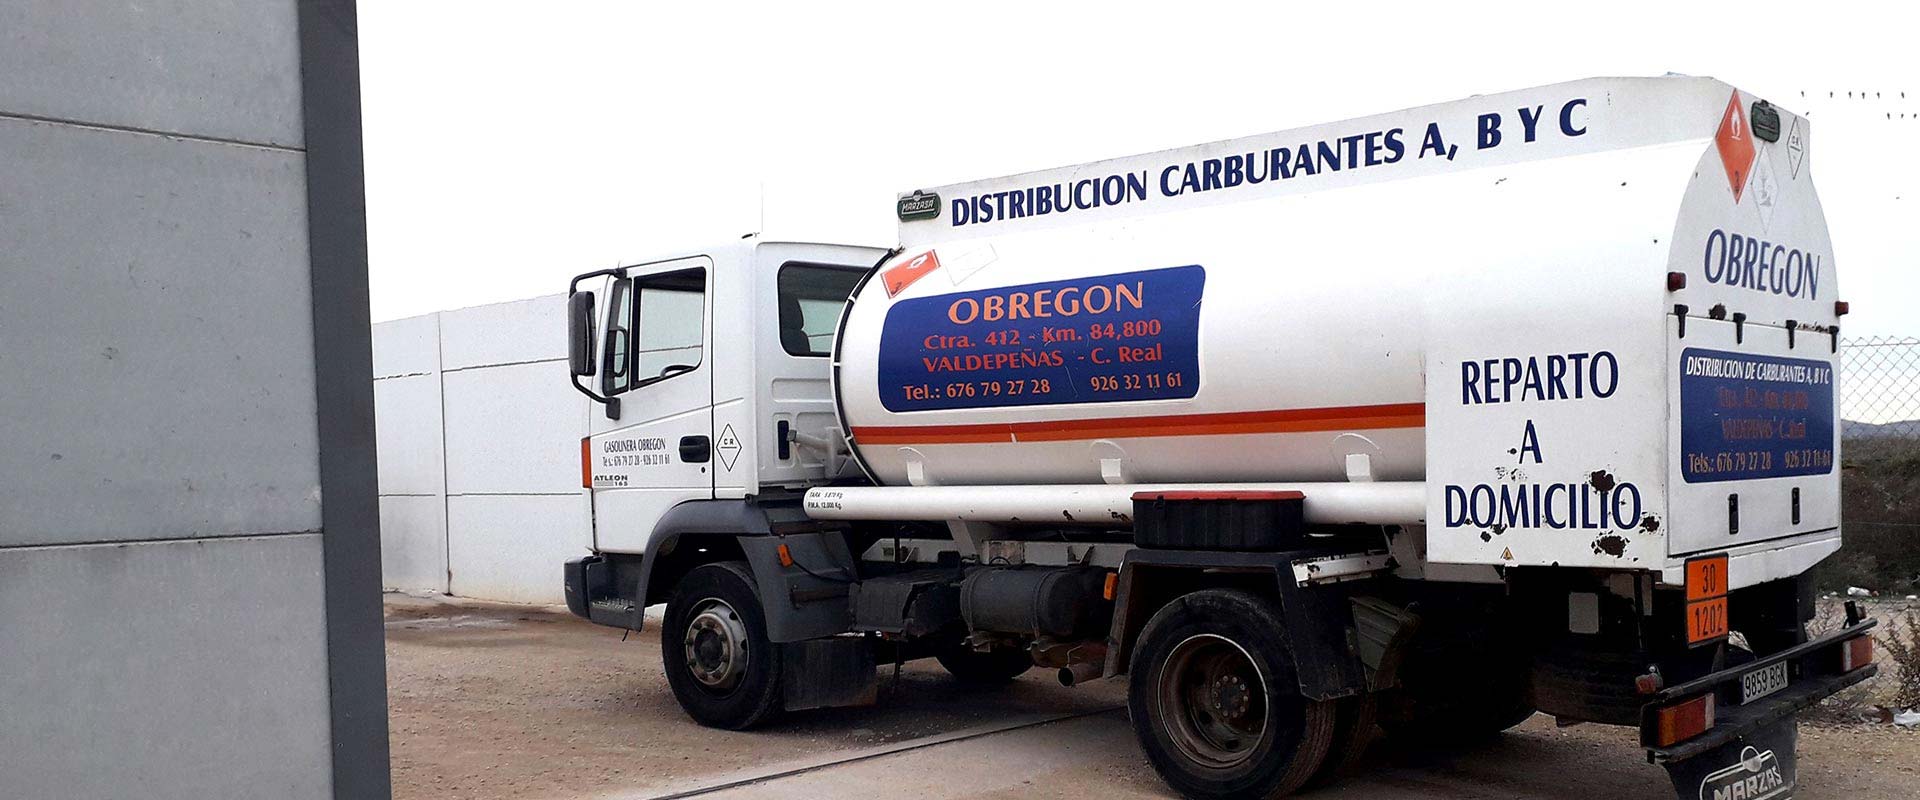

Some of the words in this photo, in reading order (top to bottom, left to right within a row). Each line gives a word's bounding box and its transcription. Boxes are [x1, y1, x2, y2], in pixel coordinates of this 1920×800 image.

[951, 171, 1147, 227] DISTRIBUCION
[1160, 127, 1404, 197] CARBURANTES
[1418, 121, 1458, 161] A,
[1477, 112, 1502, 150] B
[1517, 106, 1544, 143] Y
[1558, 99, 1588, 137] C
[902, 199, 934, 212] MARZASA
[1705, 229, 1820, 300] OBREGON
[948, 281, 1144, 325] OBREGON
[923, 334, 976, 350] Ctra.
[984, 330, 1020, 346] 412
[1042, 326, 1082, 344] Km.
[1090, 319, 1161, 341] 84,800
[922, 347, 1064, 373] VALDEPEÑAS
[1091, 347, 1111, 365] C.
[1119, 343, 1162, 362] Real
[1686, 356, 1744, 379] DISTRIBUCION
[1744, 362, 1756, 380] DE
[1756, 363, 1806, 383] CARBURANTES
[1825, 368, 1830, 384] C
[903, 384, 940, 401] Tel.:
[946, 383, 975, 398] 676
[981, 381, 1001, 397] 79
[1007, 381, 1025, 396] 27
[1031, 379, 1050, 395] 28
[1090, 376, 1118, 392] 926
[1123, 374, 1142, 390] 32
[1146, 373, 1161, 389] 11
[1167, 372, 1182, 388] 61
[1461, 351, 1619, 405] REPARTO
[604, 439, 637, 453] GASOLINERA
[638, 438, 666, 451] OBREGON
[1518, 419, 1543, 464] A
[1717, 452, 1732, 472] 676
[1735, 451, 1745, 471] 79
[1749, 451, 1758, 470] 27
[1761, 451, 1771, 470] 28
[1785, 450, 1799, 468] 926
[1802, 449, 1810, 467] 32
[1445, 482, 1641, 529] DOMICILIO
[1702, 564, 1716, 593] 30
[1695, 604, 1723, 636] 1202
[1745, 669, 1768, 698] 9859
[1769, 662, 1786, 689] BGK
